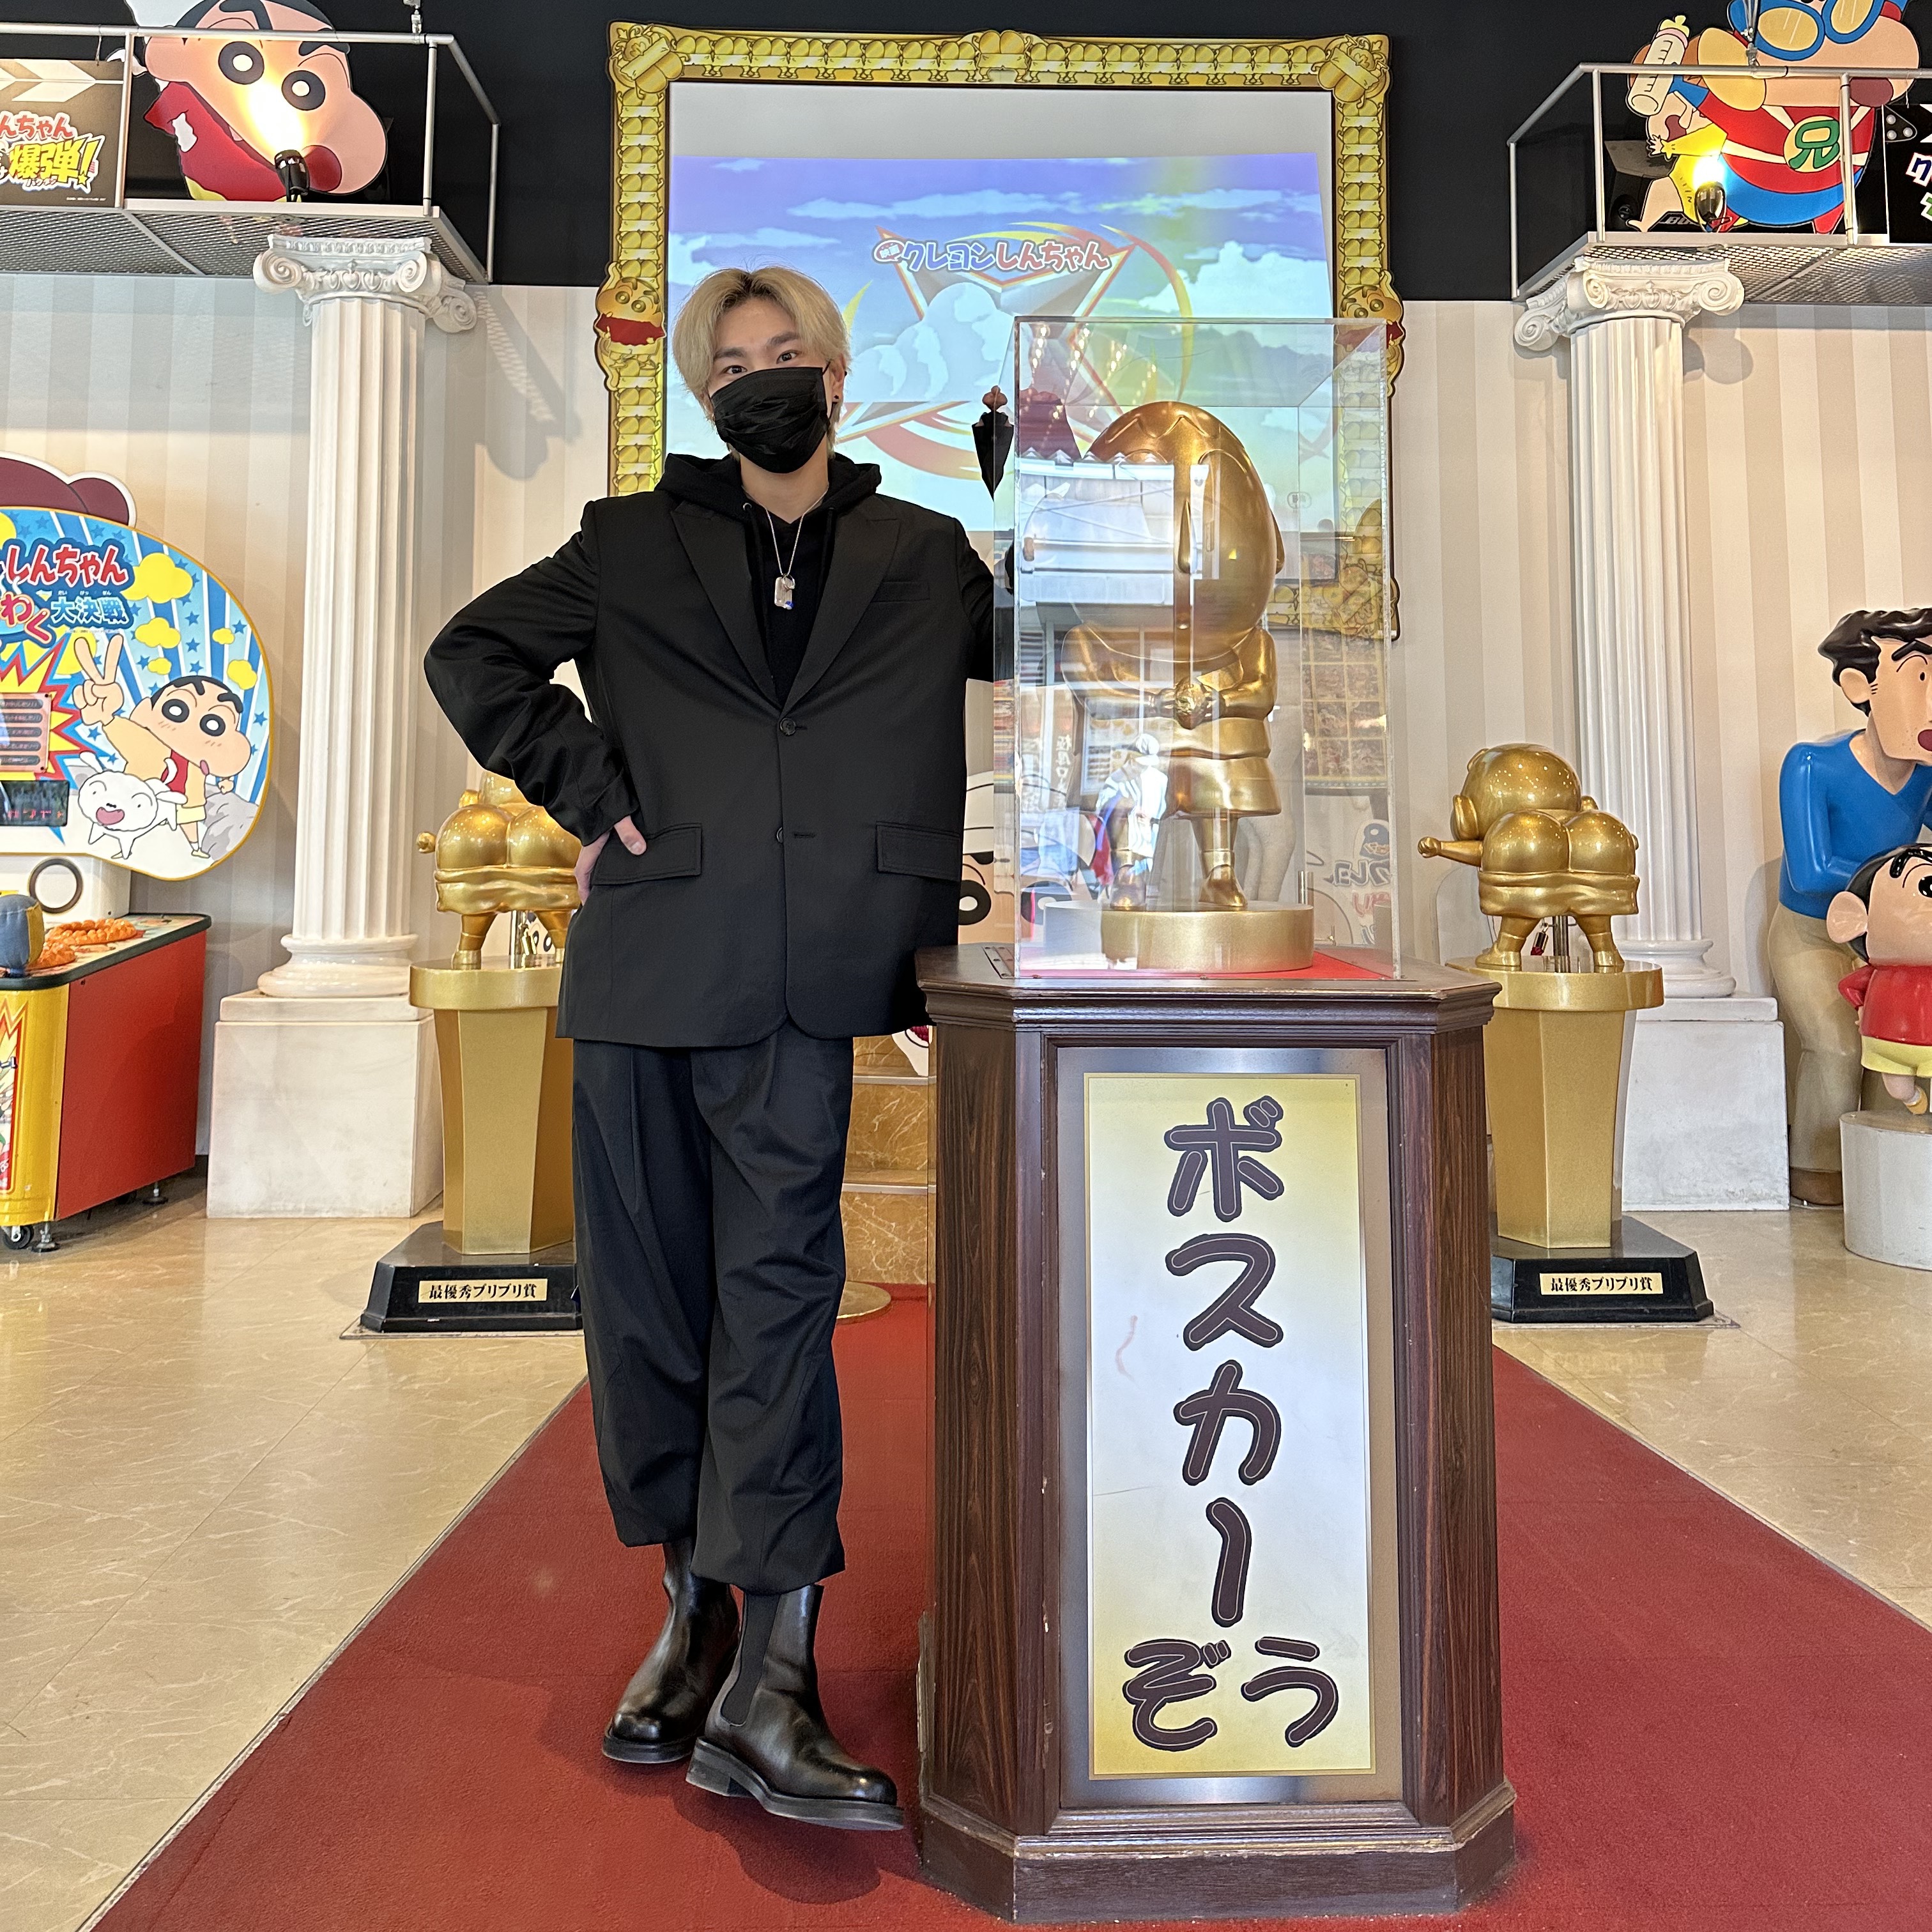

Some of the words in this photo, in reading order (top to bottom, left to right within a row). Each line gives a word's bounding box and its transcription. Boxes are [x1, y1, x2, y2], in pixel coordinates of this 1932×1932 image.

[1788, 119, 1840, 169] 兄
[903, 241, 1109, 272] クレヨンしんちゃん
[0, 545, 129, 587] しんちゃん
[50, 596, 129, 624] 大決戦
[1165, 1095, 1284, 1627] ボスカー
[1123, 1636, 1339, 1749] ぞう
